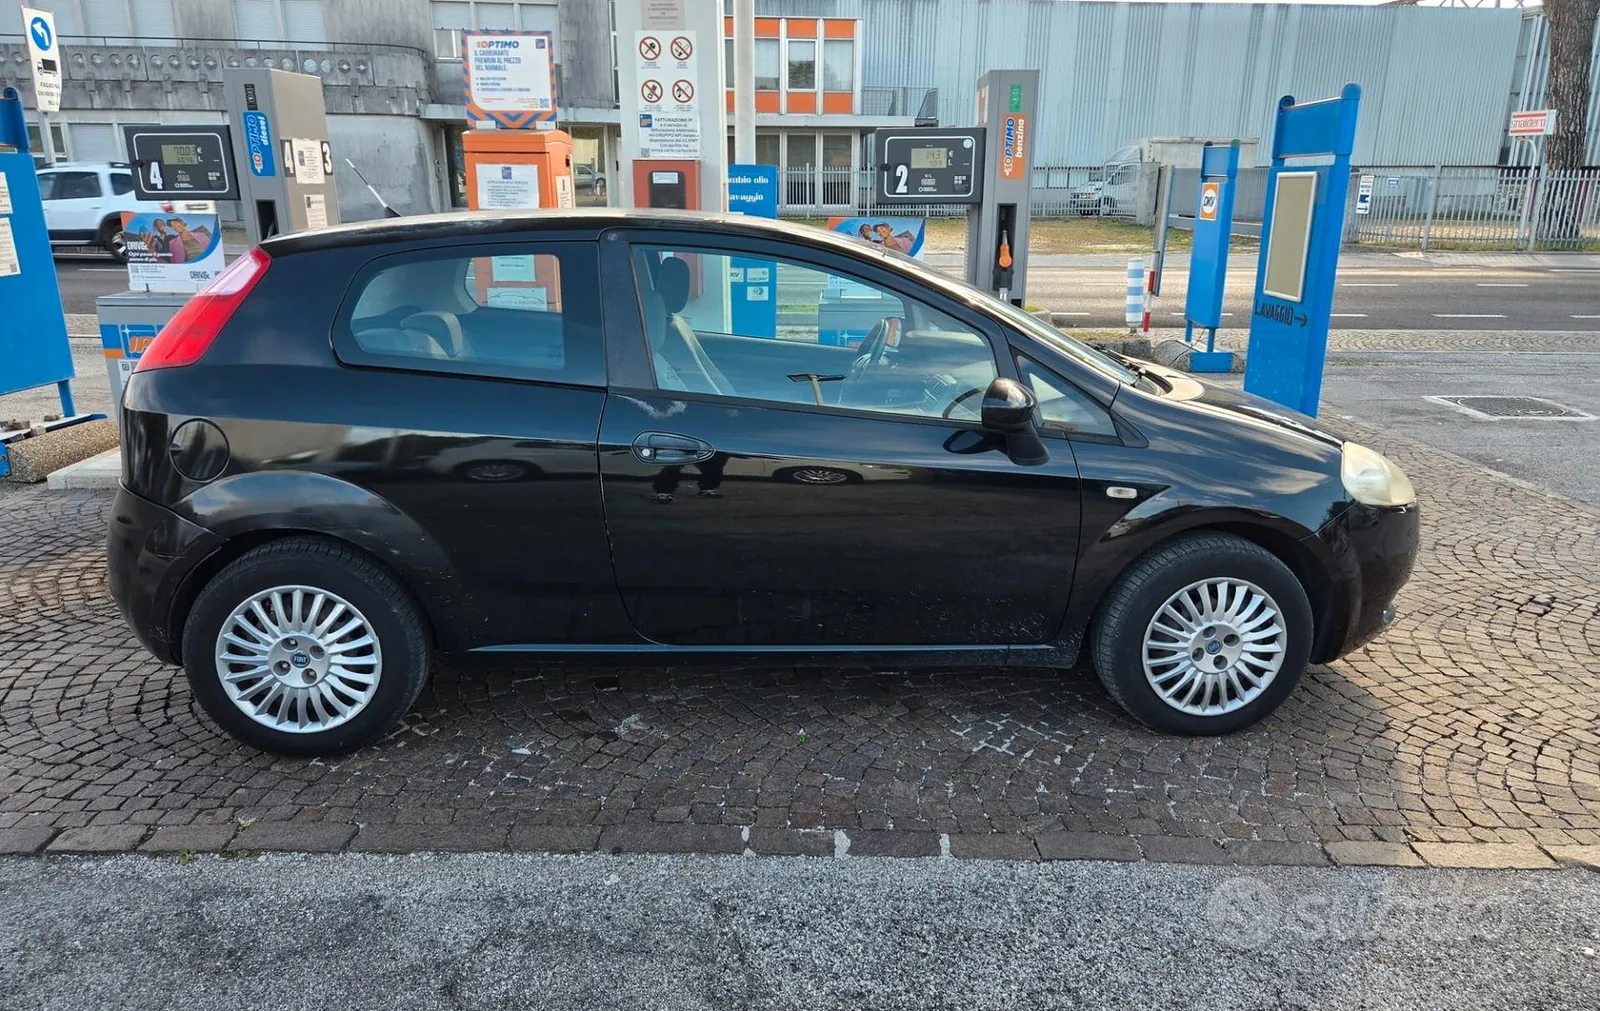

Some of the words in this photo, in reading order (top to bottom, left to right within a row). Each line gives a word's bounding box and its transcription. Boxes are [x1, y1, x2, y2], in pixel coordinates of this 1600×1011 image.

[257, 115, 269, 145] diesel
[1015, 118, 1025, 158] benzina
[284, 141, 294, 174] 4
[322, 142, 333, 174] 3
[150, 162, 163, 189] 4
[753, 175, 769, 184] olio
[895, 164, 909, 193] 2
[729, 192, 764, 202] avaggio
[1255, 299, 1294, 326] LAVAGGIO
